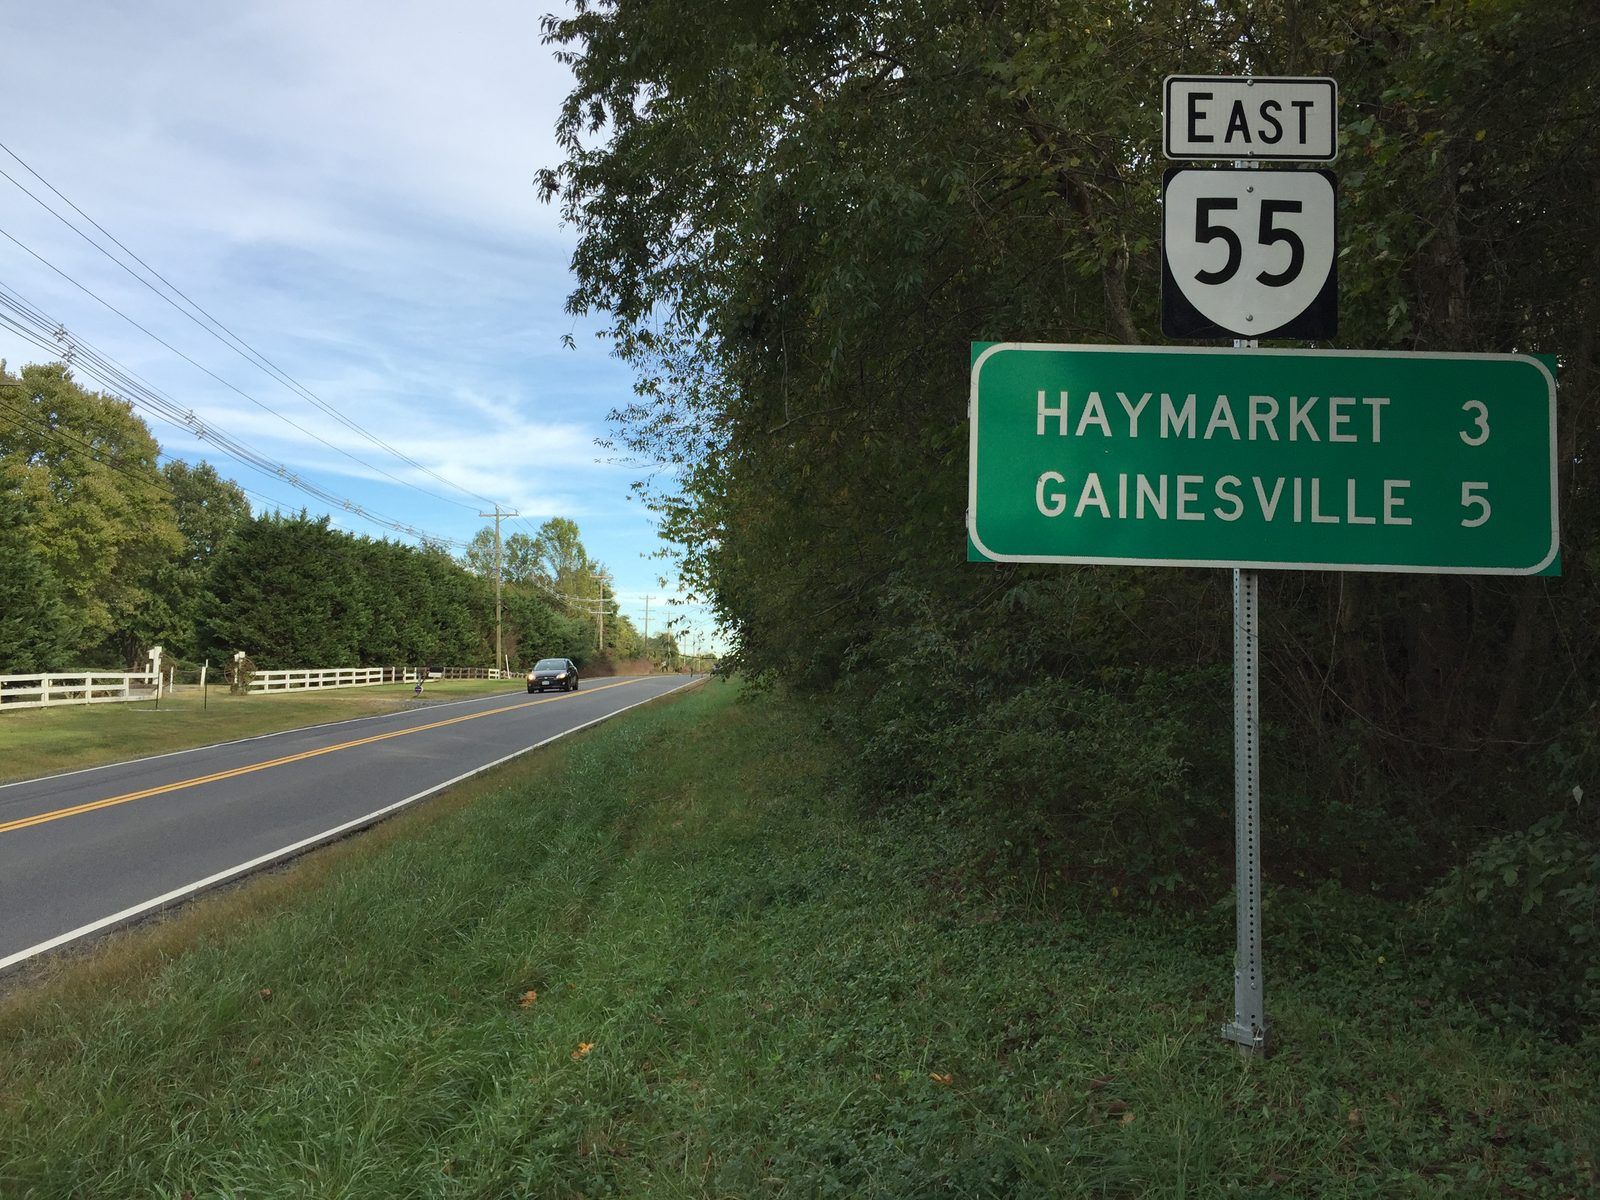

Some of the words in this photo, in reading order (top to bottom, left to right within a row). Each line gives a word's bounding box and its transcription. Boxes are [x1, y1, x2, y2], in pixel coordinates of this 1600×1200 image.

[1187, 92, 1315, 145] EAST
[1194, 197, 1305, 288] 55
[1036, 390, 1391, 443] HAYMARKET
[1458, 399, 1491, 447] 3
[1035, 471, 1413, 526] GAINESVILLE
[1459, 481, 1492, 528] 5
